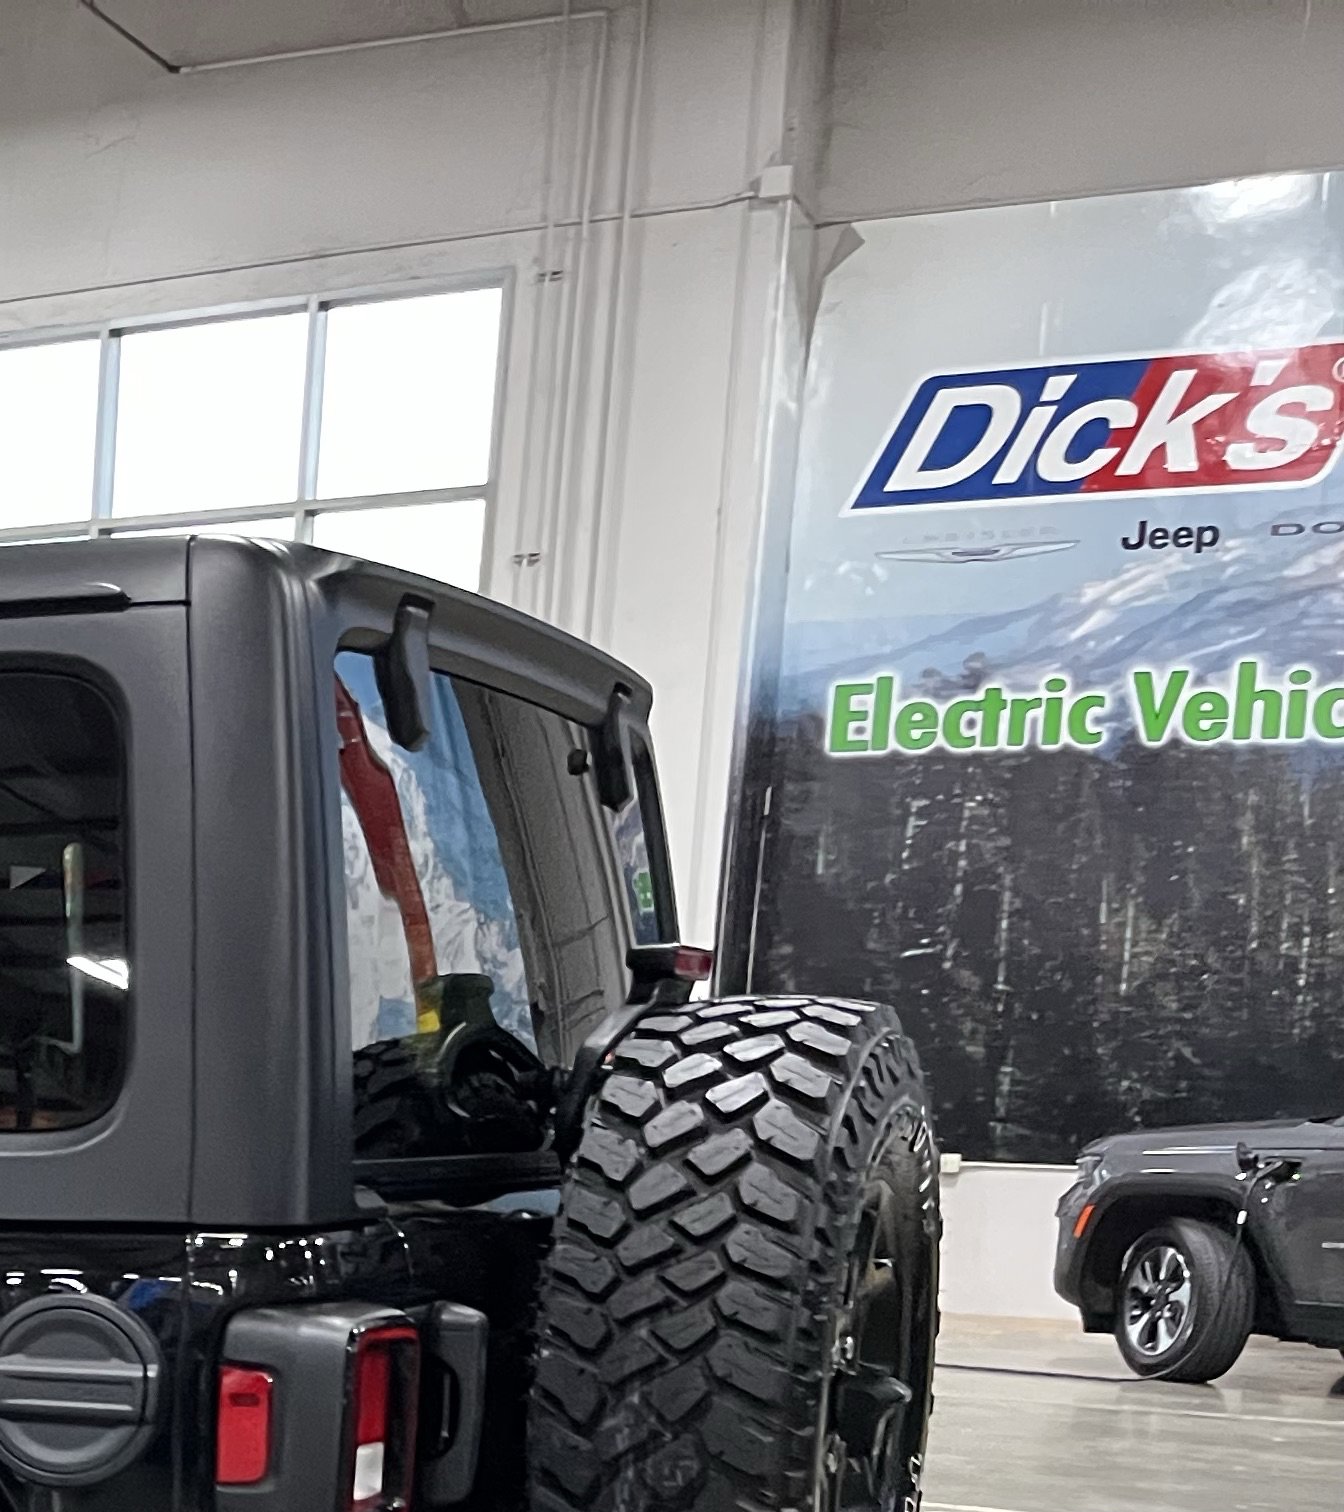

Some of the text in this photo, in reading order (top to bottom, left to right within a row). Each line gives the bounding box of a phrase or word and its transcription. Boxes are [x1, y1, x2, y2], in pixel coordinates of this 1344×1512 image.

[884, 358, 1335, 491] Dick's
[1122, 521, 1220, 554] Jeep
[828, 661, 1344, 753] Electric Vehic
